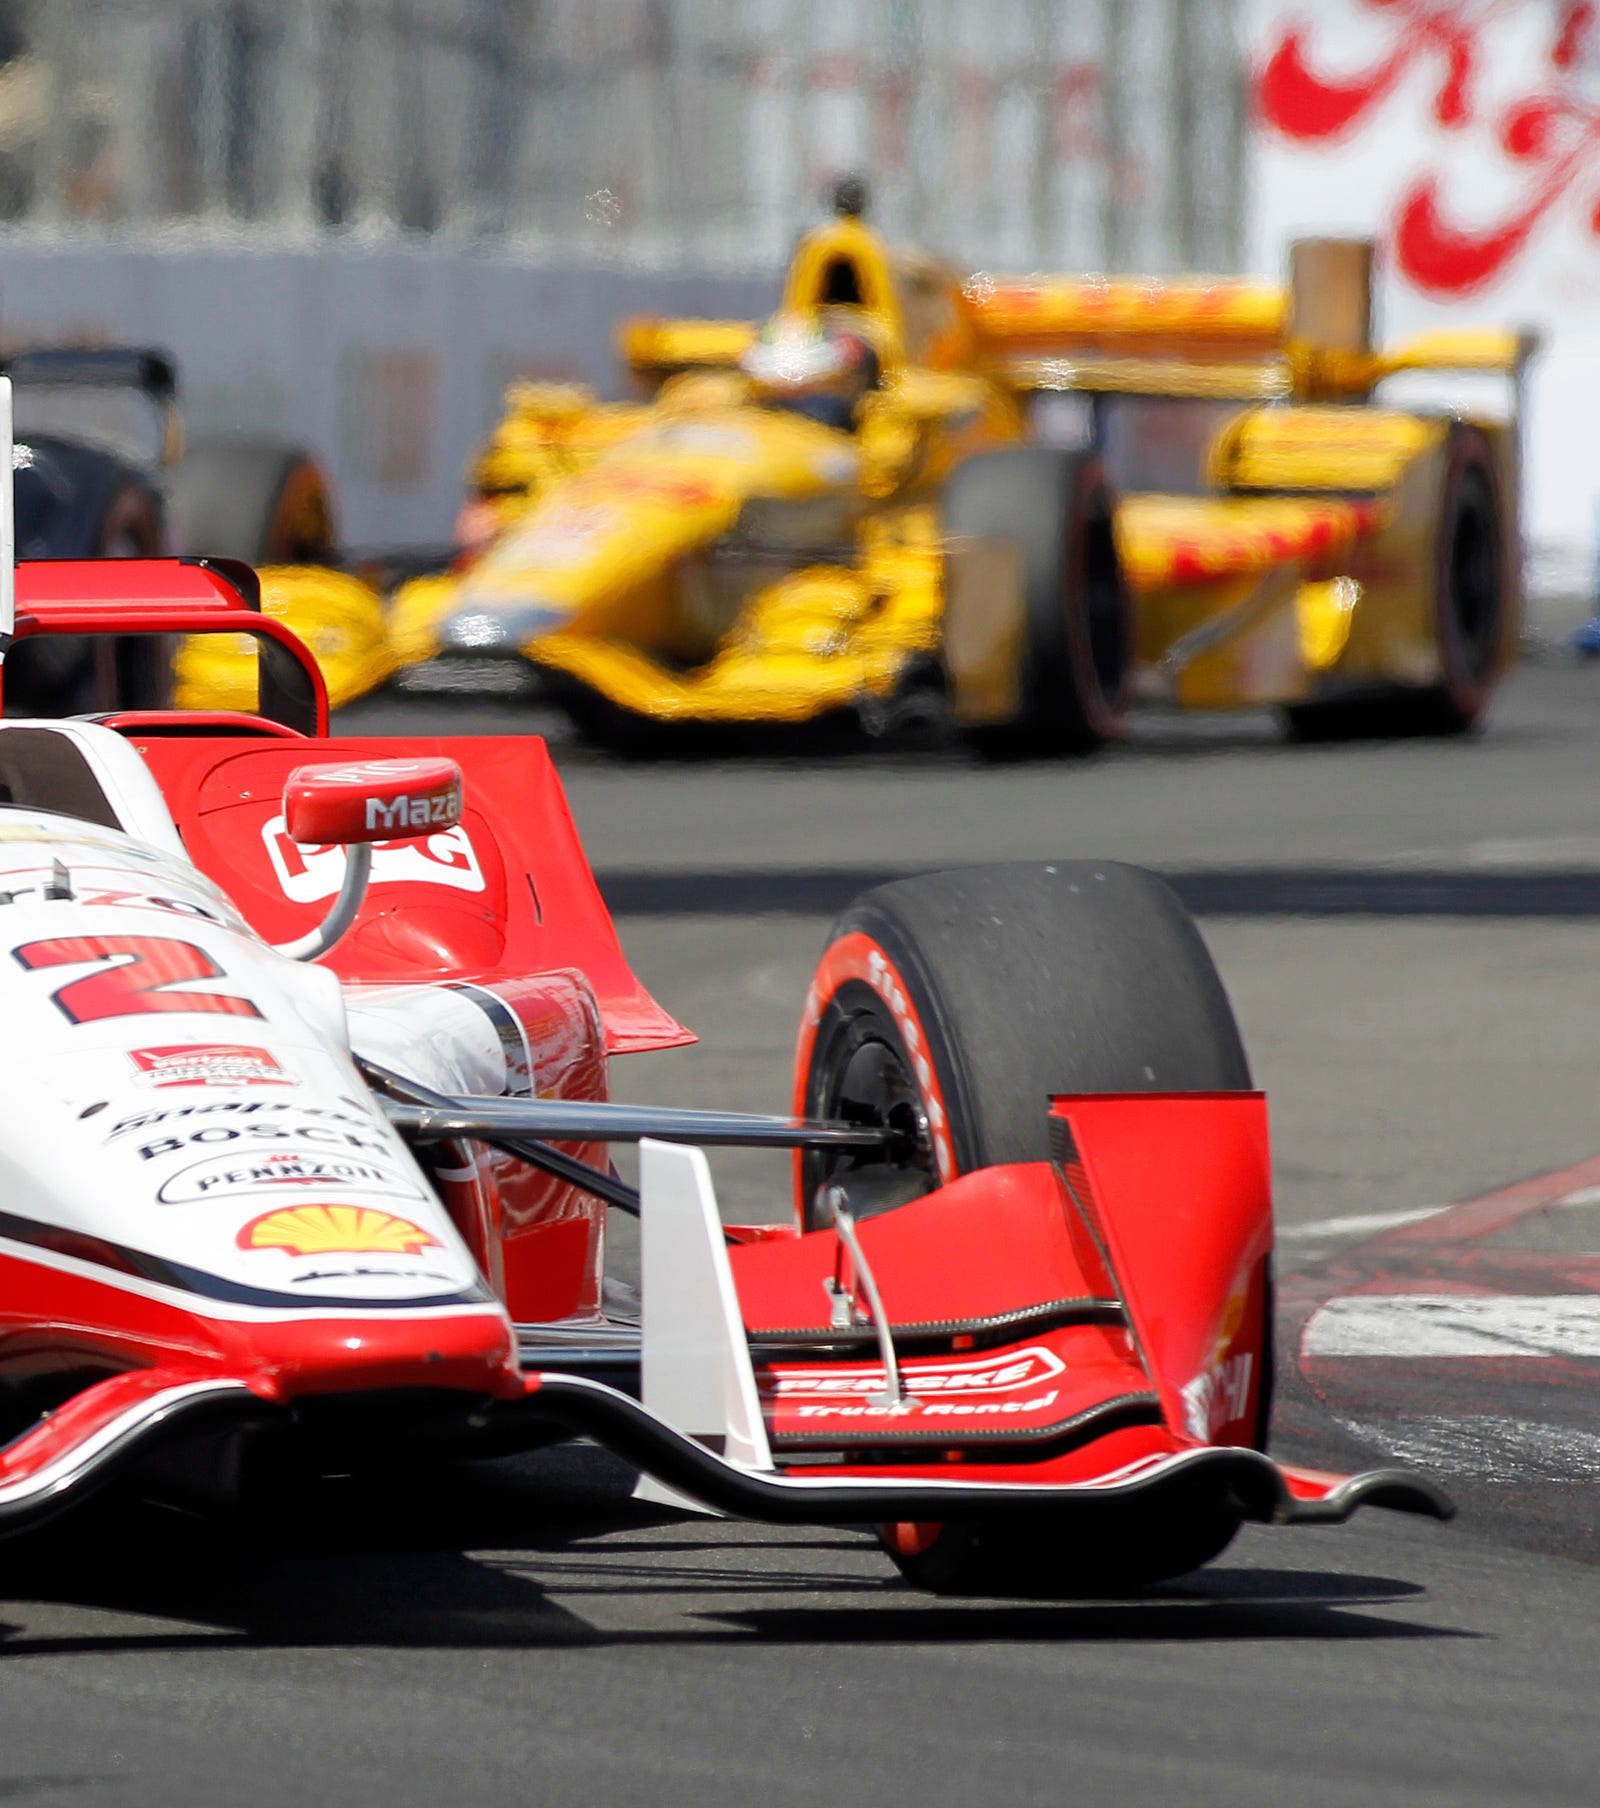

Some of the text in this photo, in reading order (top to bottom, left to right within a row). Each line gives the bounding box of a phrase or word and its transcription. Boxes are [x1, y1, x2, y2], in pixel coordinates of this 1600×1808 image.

[365, 792, 458, 831] Maza
[10, 935, 267, 1026] 2
[138, 1124, 391, 1161] BOSCH
[196, 1163, 386, 1192] PENNZOIL
[920, 1390, 1060, 1417] Rental
